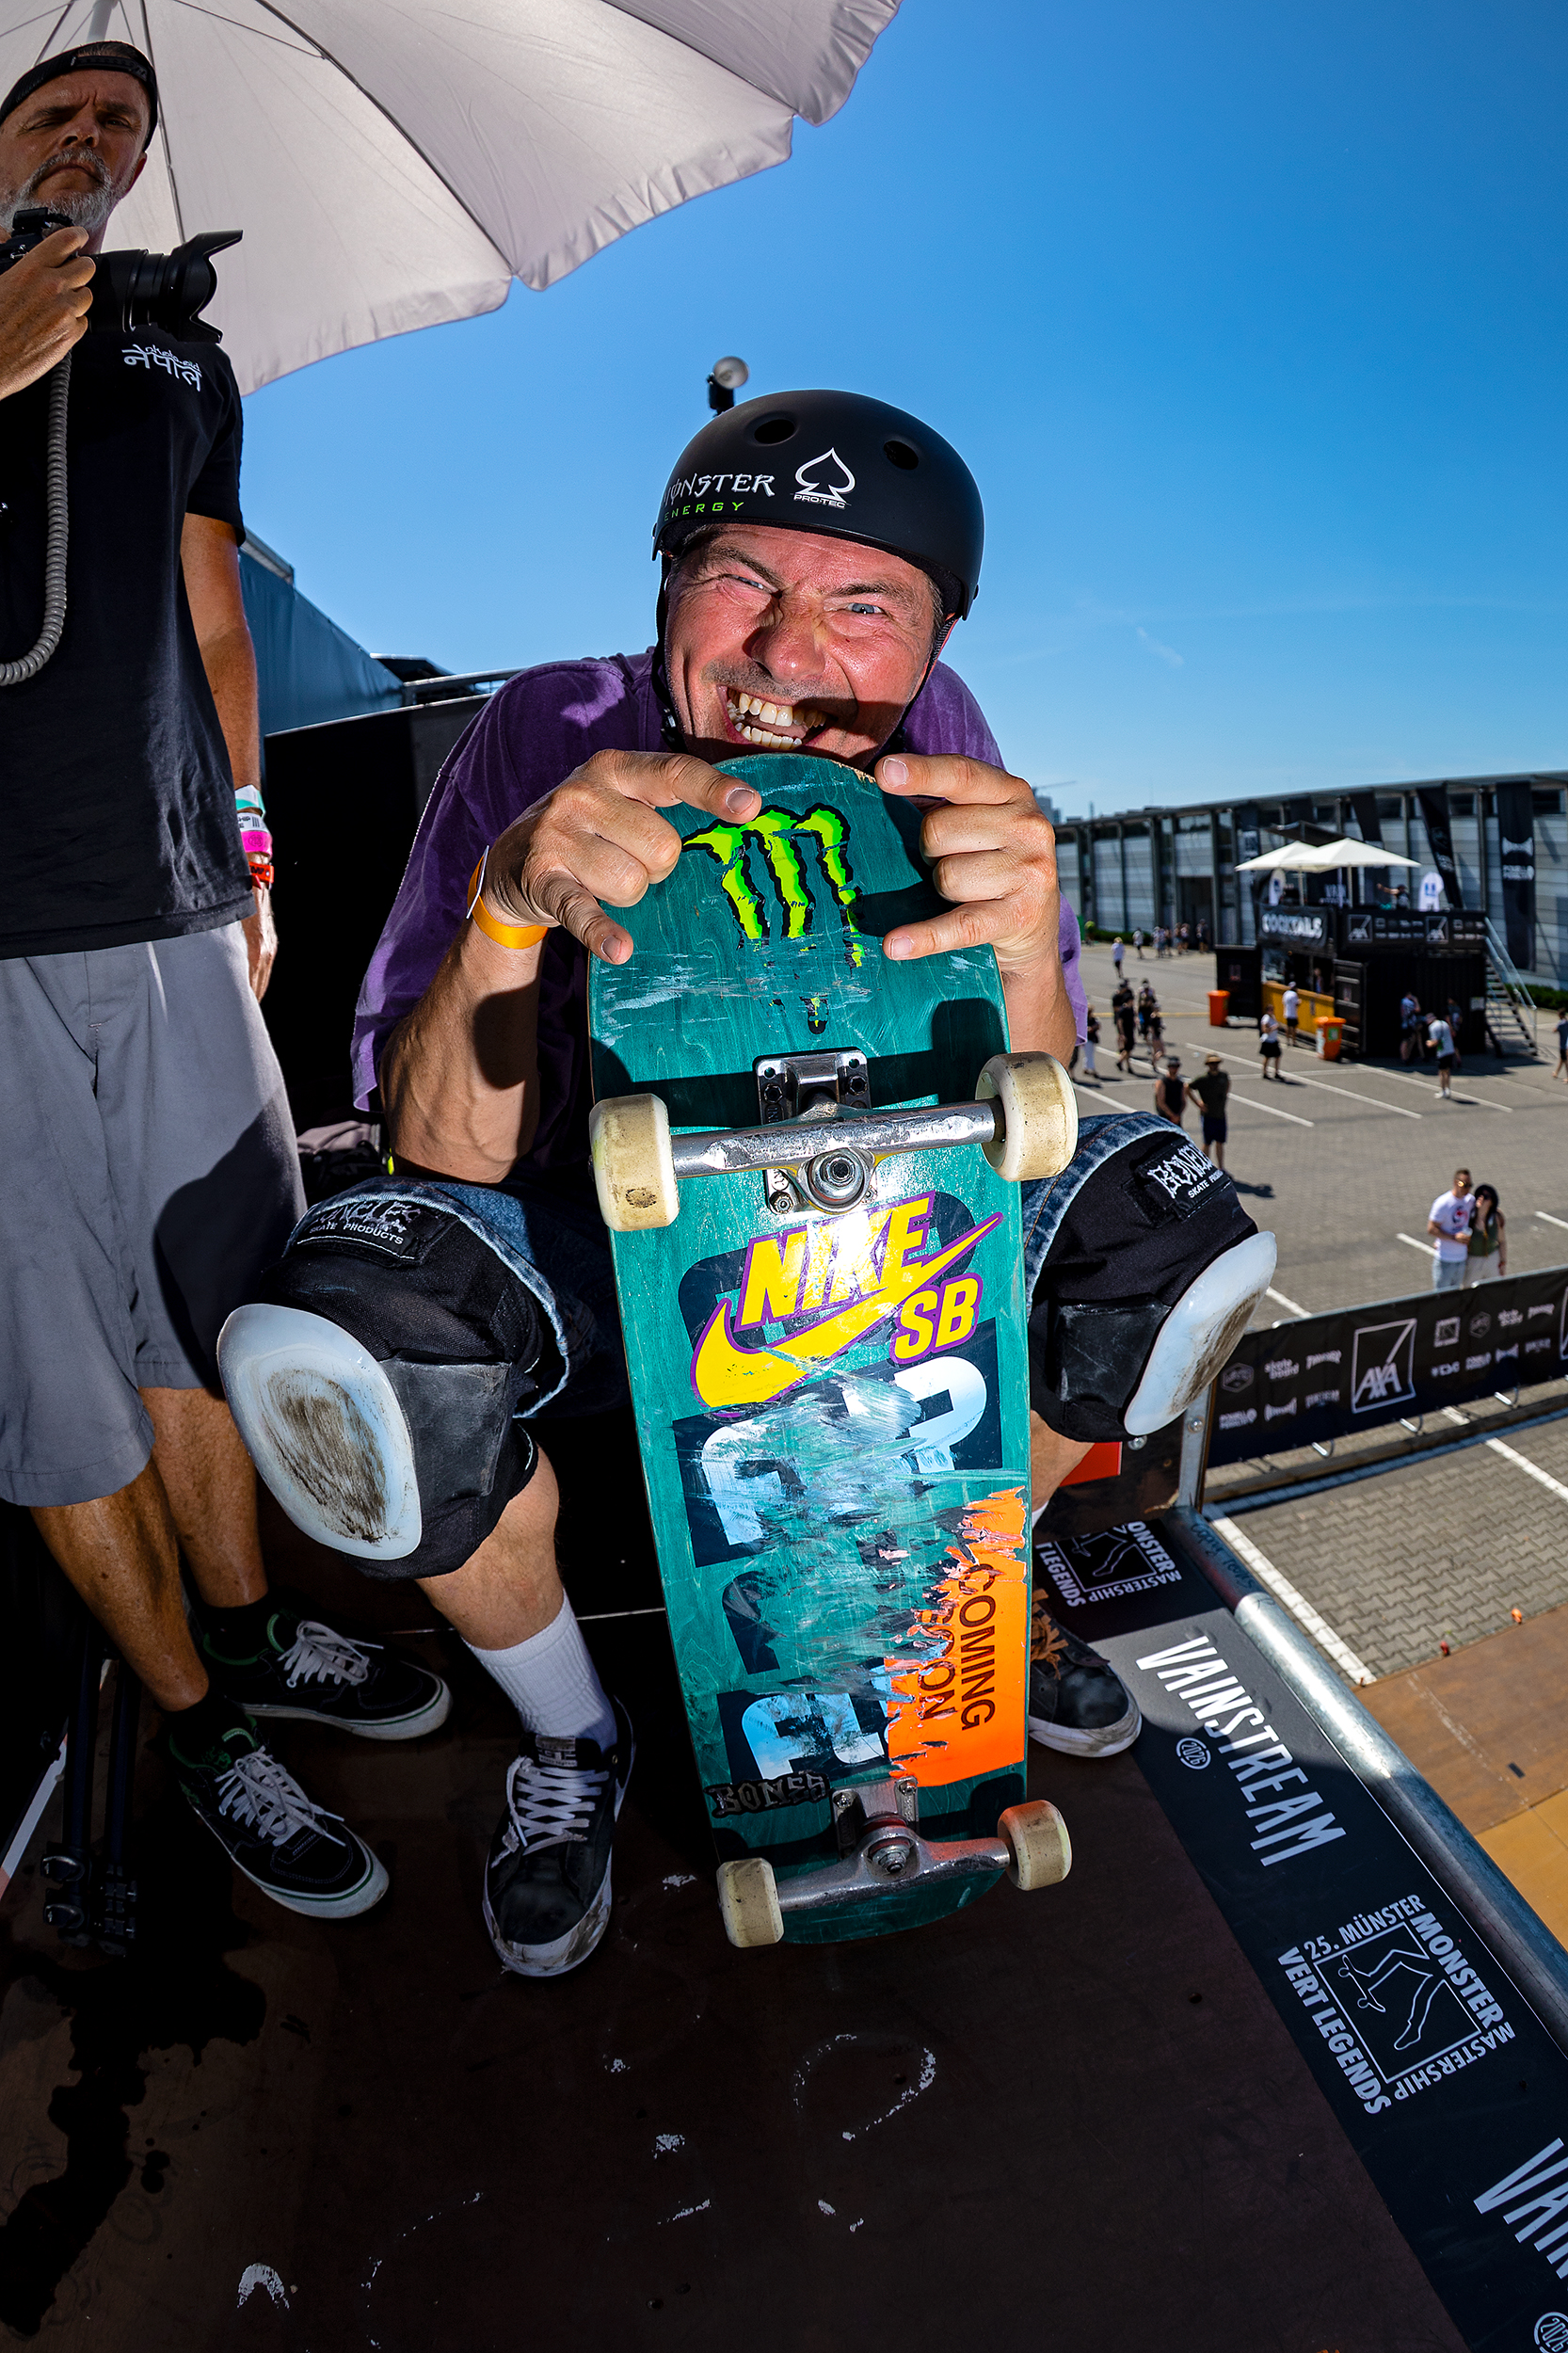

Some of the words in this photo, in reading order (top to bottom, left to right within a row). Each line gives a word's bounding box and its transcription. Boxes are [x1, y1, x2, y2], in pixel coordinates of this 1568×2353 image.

[121, 344, 202, 392] नेपाल
[664, 502, 744, 521] ENERGY
[1261, 913, 1323, 939] COCKTAILS
[1188, 1179, 1210, 1198] SKATE
[343, 1224, 405, 1245] PRODUCTS
[739, 1193, 934, 1329] NIKE
[892, 1274, 981, 1362] SB
[1354, 1361, 1402, 1406] AXA
[1127, 1520, 1176, 1573] ONSTER
[1039, 1549, 1087, 1608] LEGENDS
[1088, 1569, 1183, 1603] MASTERSHIP
[958, 1562, 998, 1731] COMING
[1135, 1635, 1347, 1867] VAINSTREAM
[1182, 1741, 1207, 1767] 2026
[710, 1773, 828, 1815] BONES
[1304, 1935, 1340, 1961] 25.
[1338, 1894, 1427, 1945] MÜNSTER
[1410, 1912, 1505, 2029] MONSTER
[1277, 1946, 1329, 2008] VERT
[1311, 2007, 1392, 2114] LEGENDS
[1393, 2021, 1516, 2102] MASTERSHIP
